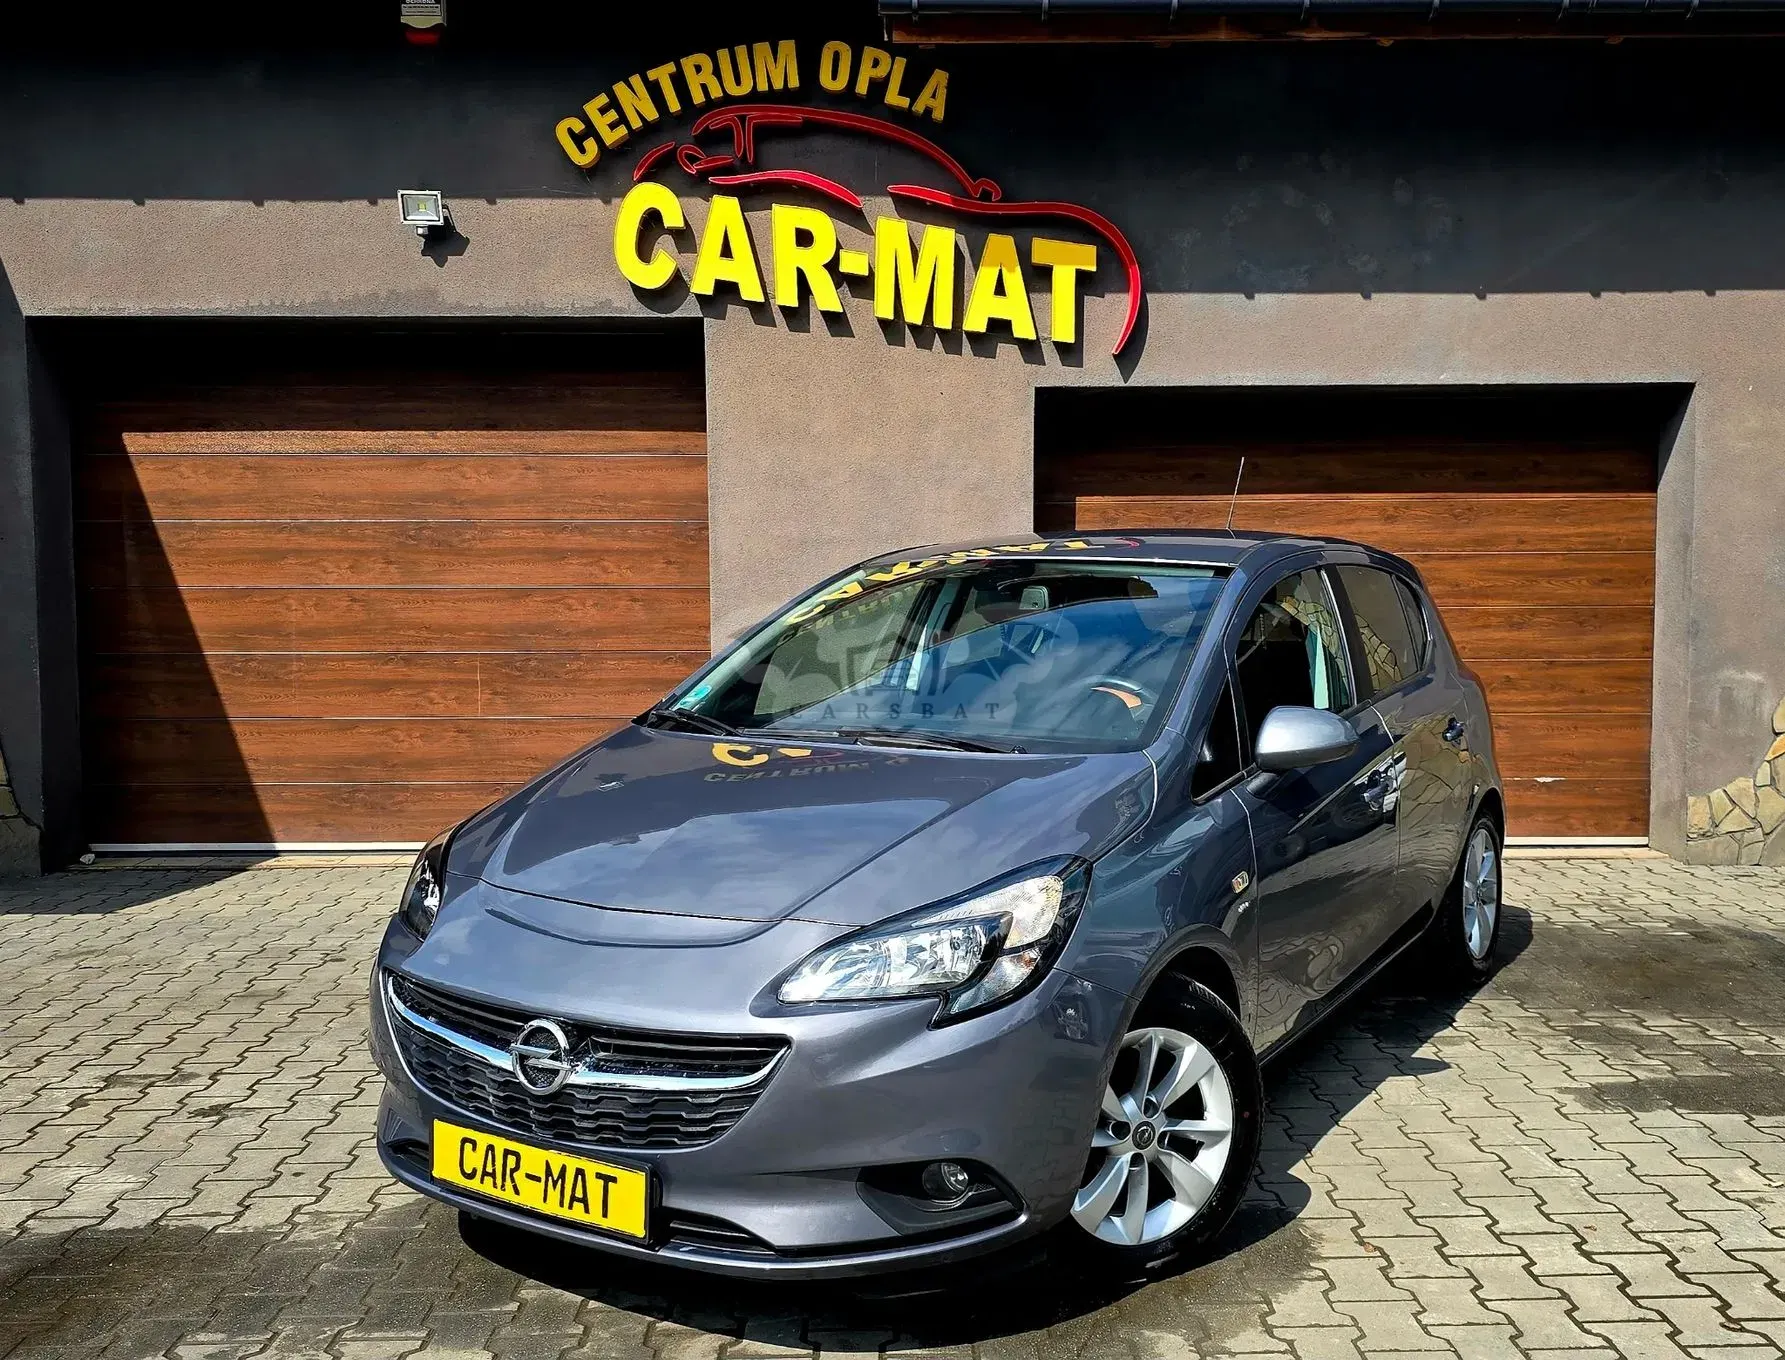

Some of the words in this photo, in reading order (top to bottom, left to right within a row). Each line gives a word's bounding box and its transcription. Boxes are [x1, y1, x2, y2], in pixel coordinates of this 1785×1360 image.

[555, 39, 799, 168] CENTRUM
[819, 40, 950, 122] OPLA
[612, 182, 1098, 344] CAR-MAT
[458, 1136, 618, 1219] CAR-MAT
